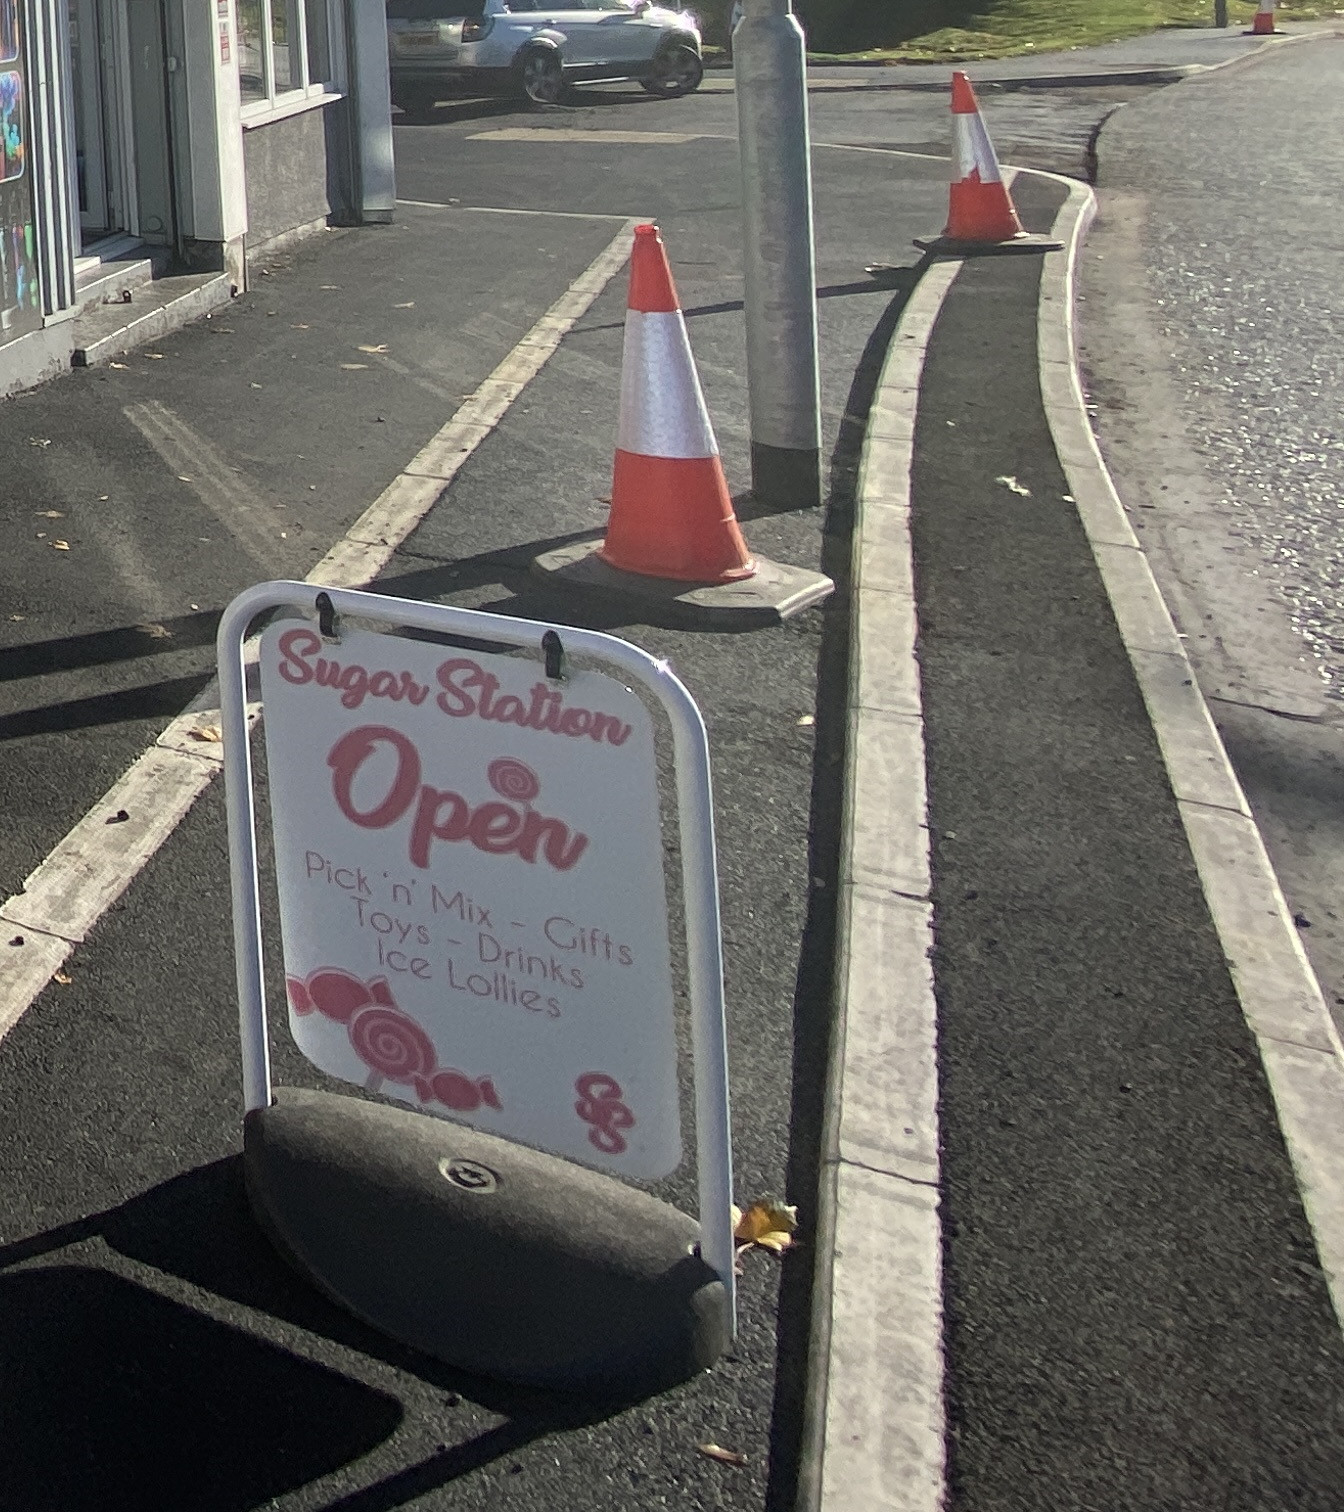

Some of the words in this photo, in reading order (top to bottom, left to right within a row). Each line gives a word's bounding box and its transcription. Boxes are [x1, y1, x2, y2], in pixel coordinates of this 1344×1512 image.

[277, 628, 429, 710] Sugar
[436, 657, 633, 748] Station
[326, 723, 590, 872] Open
[305, 850, 372, 894] Pick
[431, 885, 493, 928] Mix
[543, 915, 634, 967] Gifts
[349, 895, 431, 946] Toys
[478, 933, 586, 989] Drinks
[377, 939, 433, 981] Ice
[448, 959, 563, 1018] Lollies
